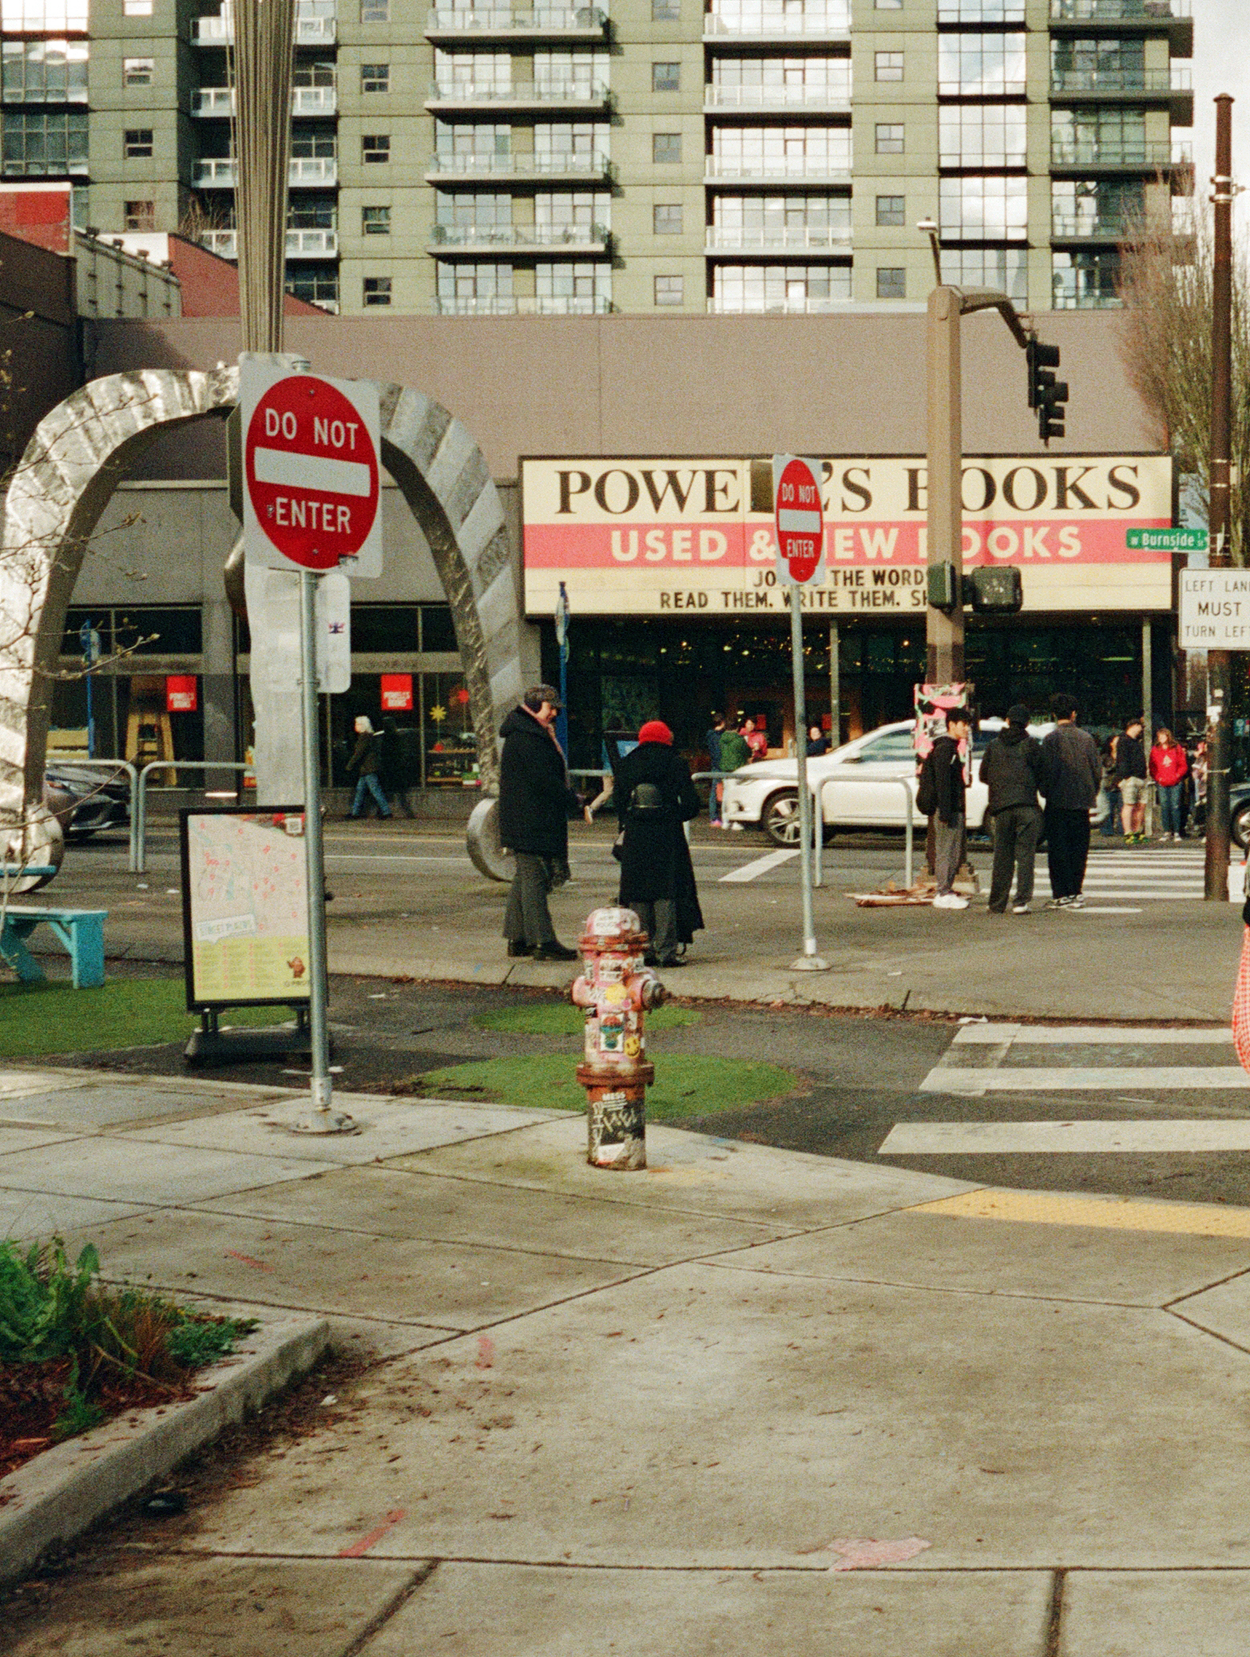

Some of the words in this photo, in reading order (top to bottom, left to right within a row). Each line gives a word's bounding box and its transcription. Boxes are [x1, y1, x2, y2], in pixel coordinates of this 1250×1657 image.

[265, 408, 298, 440] DO
[314, 416, 359, 450] NOT
[554, 461, 873, 515] POWE'S
[782, 482, 795, 502] DO
[799, 485, 815, 504] NOT
[276, 497, 352, 534] ENTER
[611, 529, 728, 562] USED
[750, 529, 777, 560] &
[824, 528, 899, 560] EW
[787, 538, 814, 559] ENTER
[1142, 532, 1195, 547] Burnside
[831, 569, 864, 587] THE
[1185, 580, 1214, 593] LEFT
[660, 592, 709, 609] READ
[721, 590, 774, 609] THEM.
[782, 590, 839, 608] WRITE
[850, 589, 901, 608] THEM.
[1197, 602, 1242, 617] MUST
[1185, 625, 1216, 638] TURN
